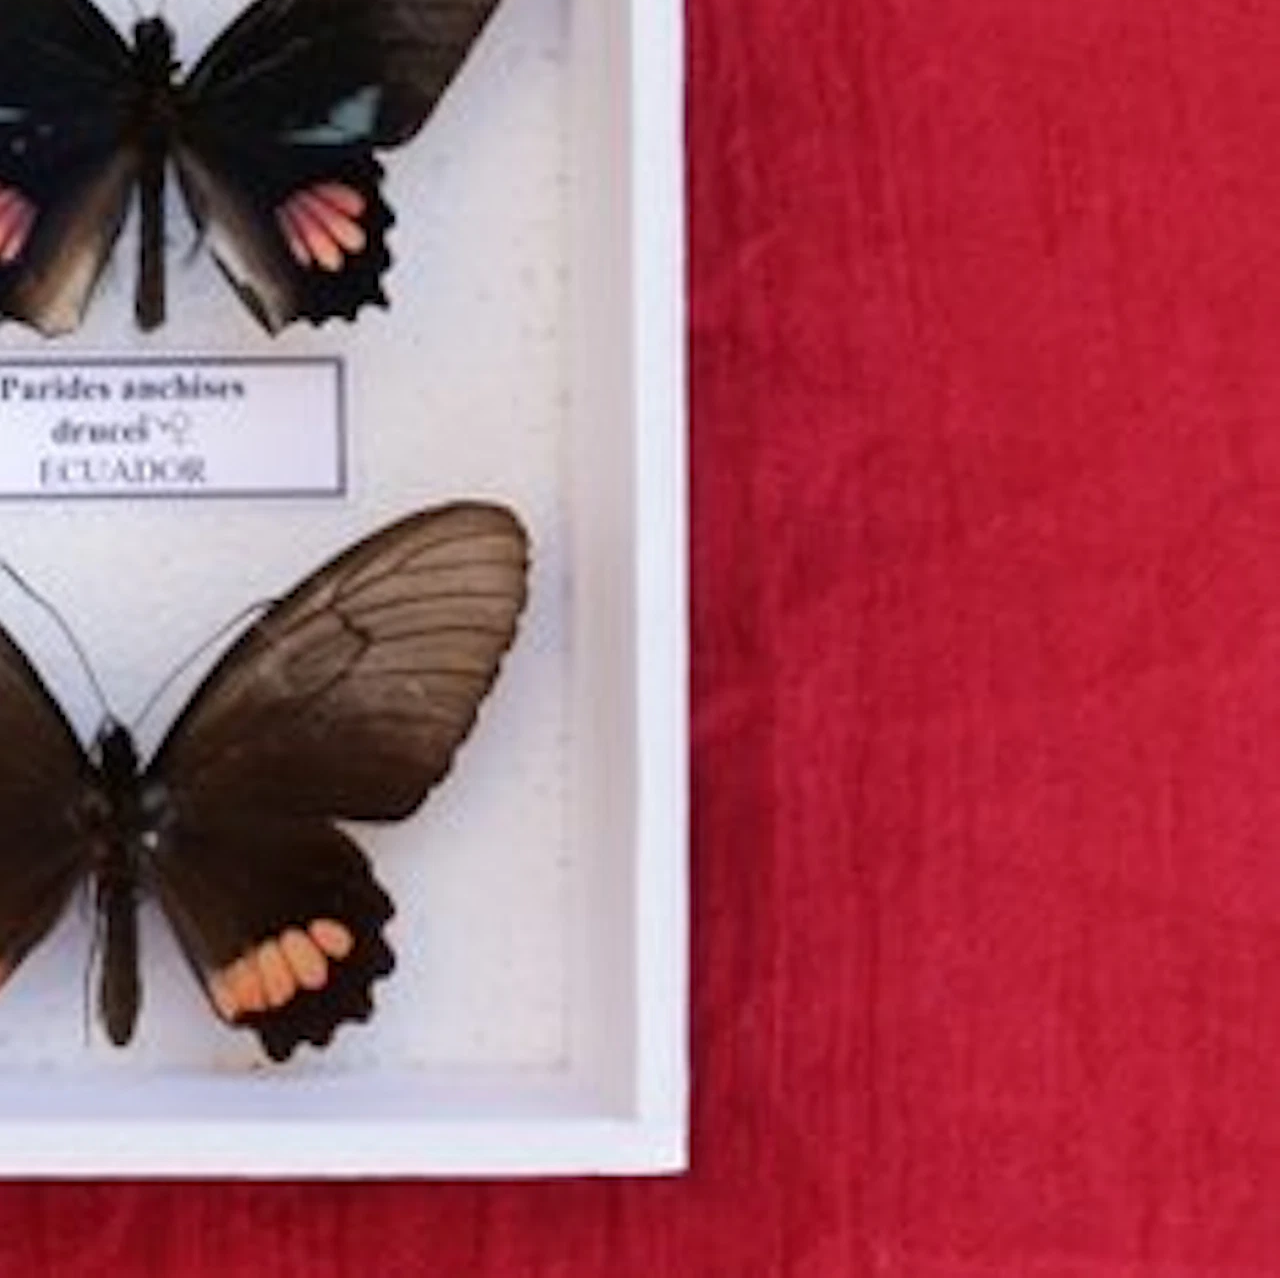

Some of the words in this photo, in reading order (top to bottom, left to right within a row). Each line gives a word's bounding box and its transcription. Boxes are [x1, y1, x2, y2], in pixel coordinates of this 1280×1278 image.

[0, 376, 111, 402] Parides
[121, 375, 246, 401] anchises
[51, 417, 149, 445] drucei
[40, 457, 206, 484] ECUADOR
